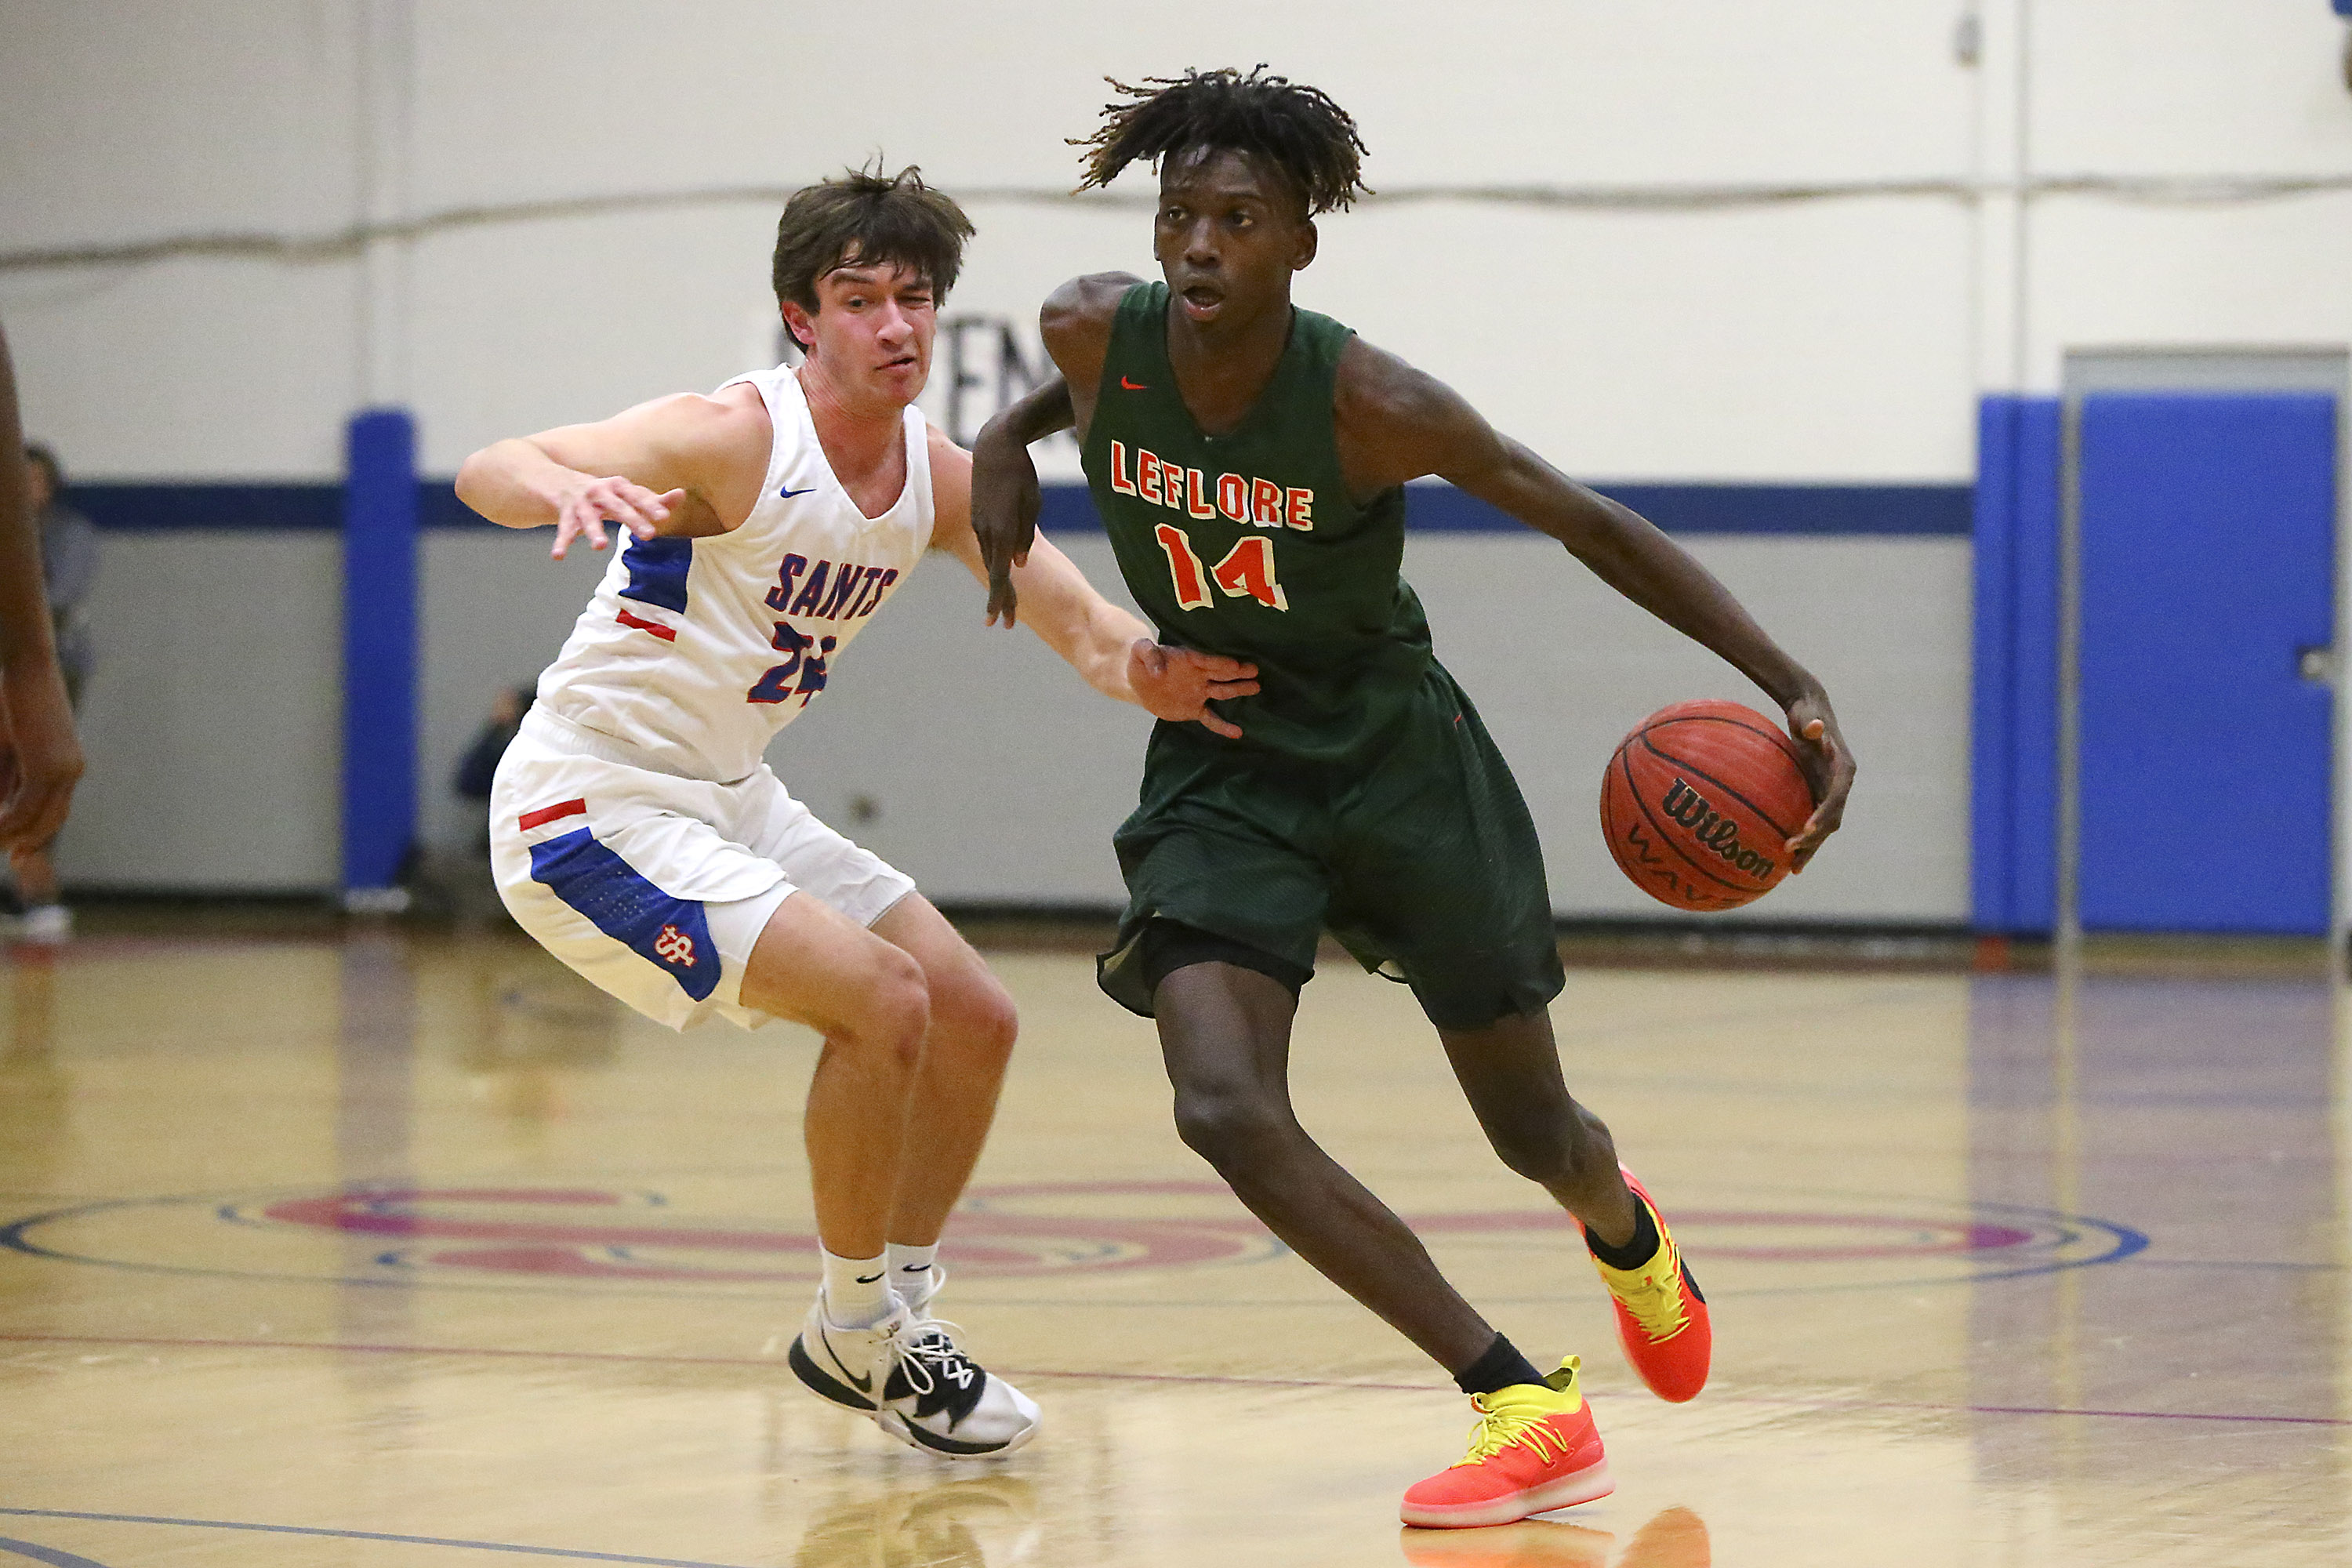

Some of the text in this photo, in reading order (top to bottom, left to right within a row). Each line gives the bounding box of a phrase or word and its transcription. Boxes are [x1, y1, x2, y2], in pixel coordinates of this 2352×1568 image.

[1110, 439, 1314, 531] LEFLORE
[1154, 522, 1289, 612] 14
[1661, 776, 1774, 880] Wilson
